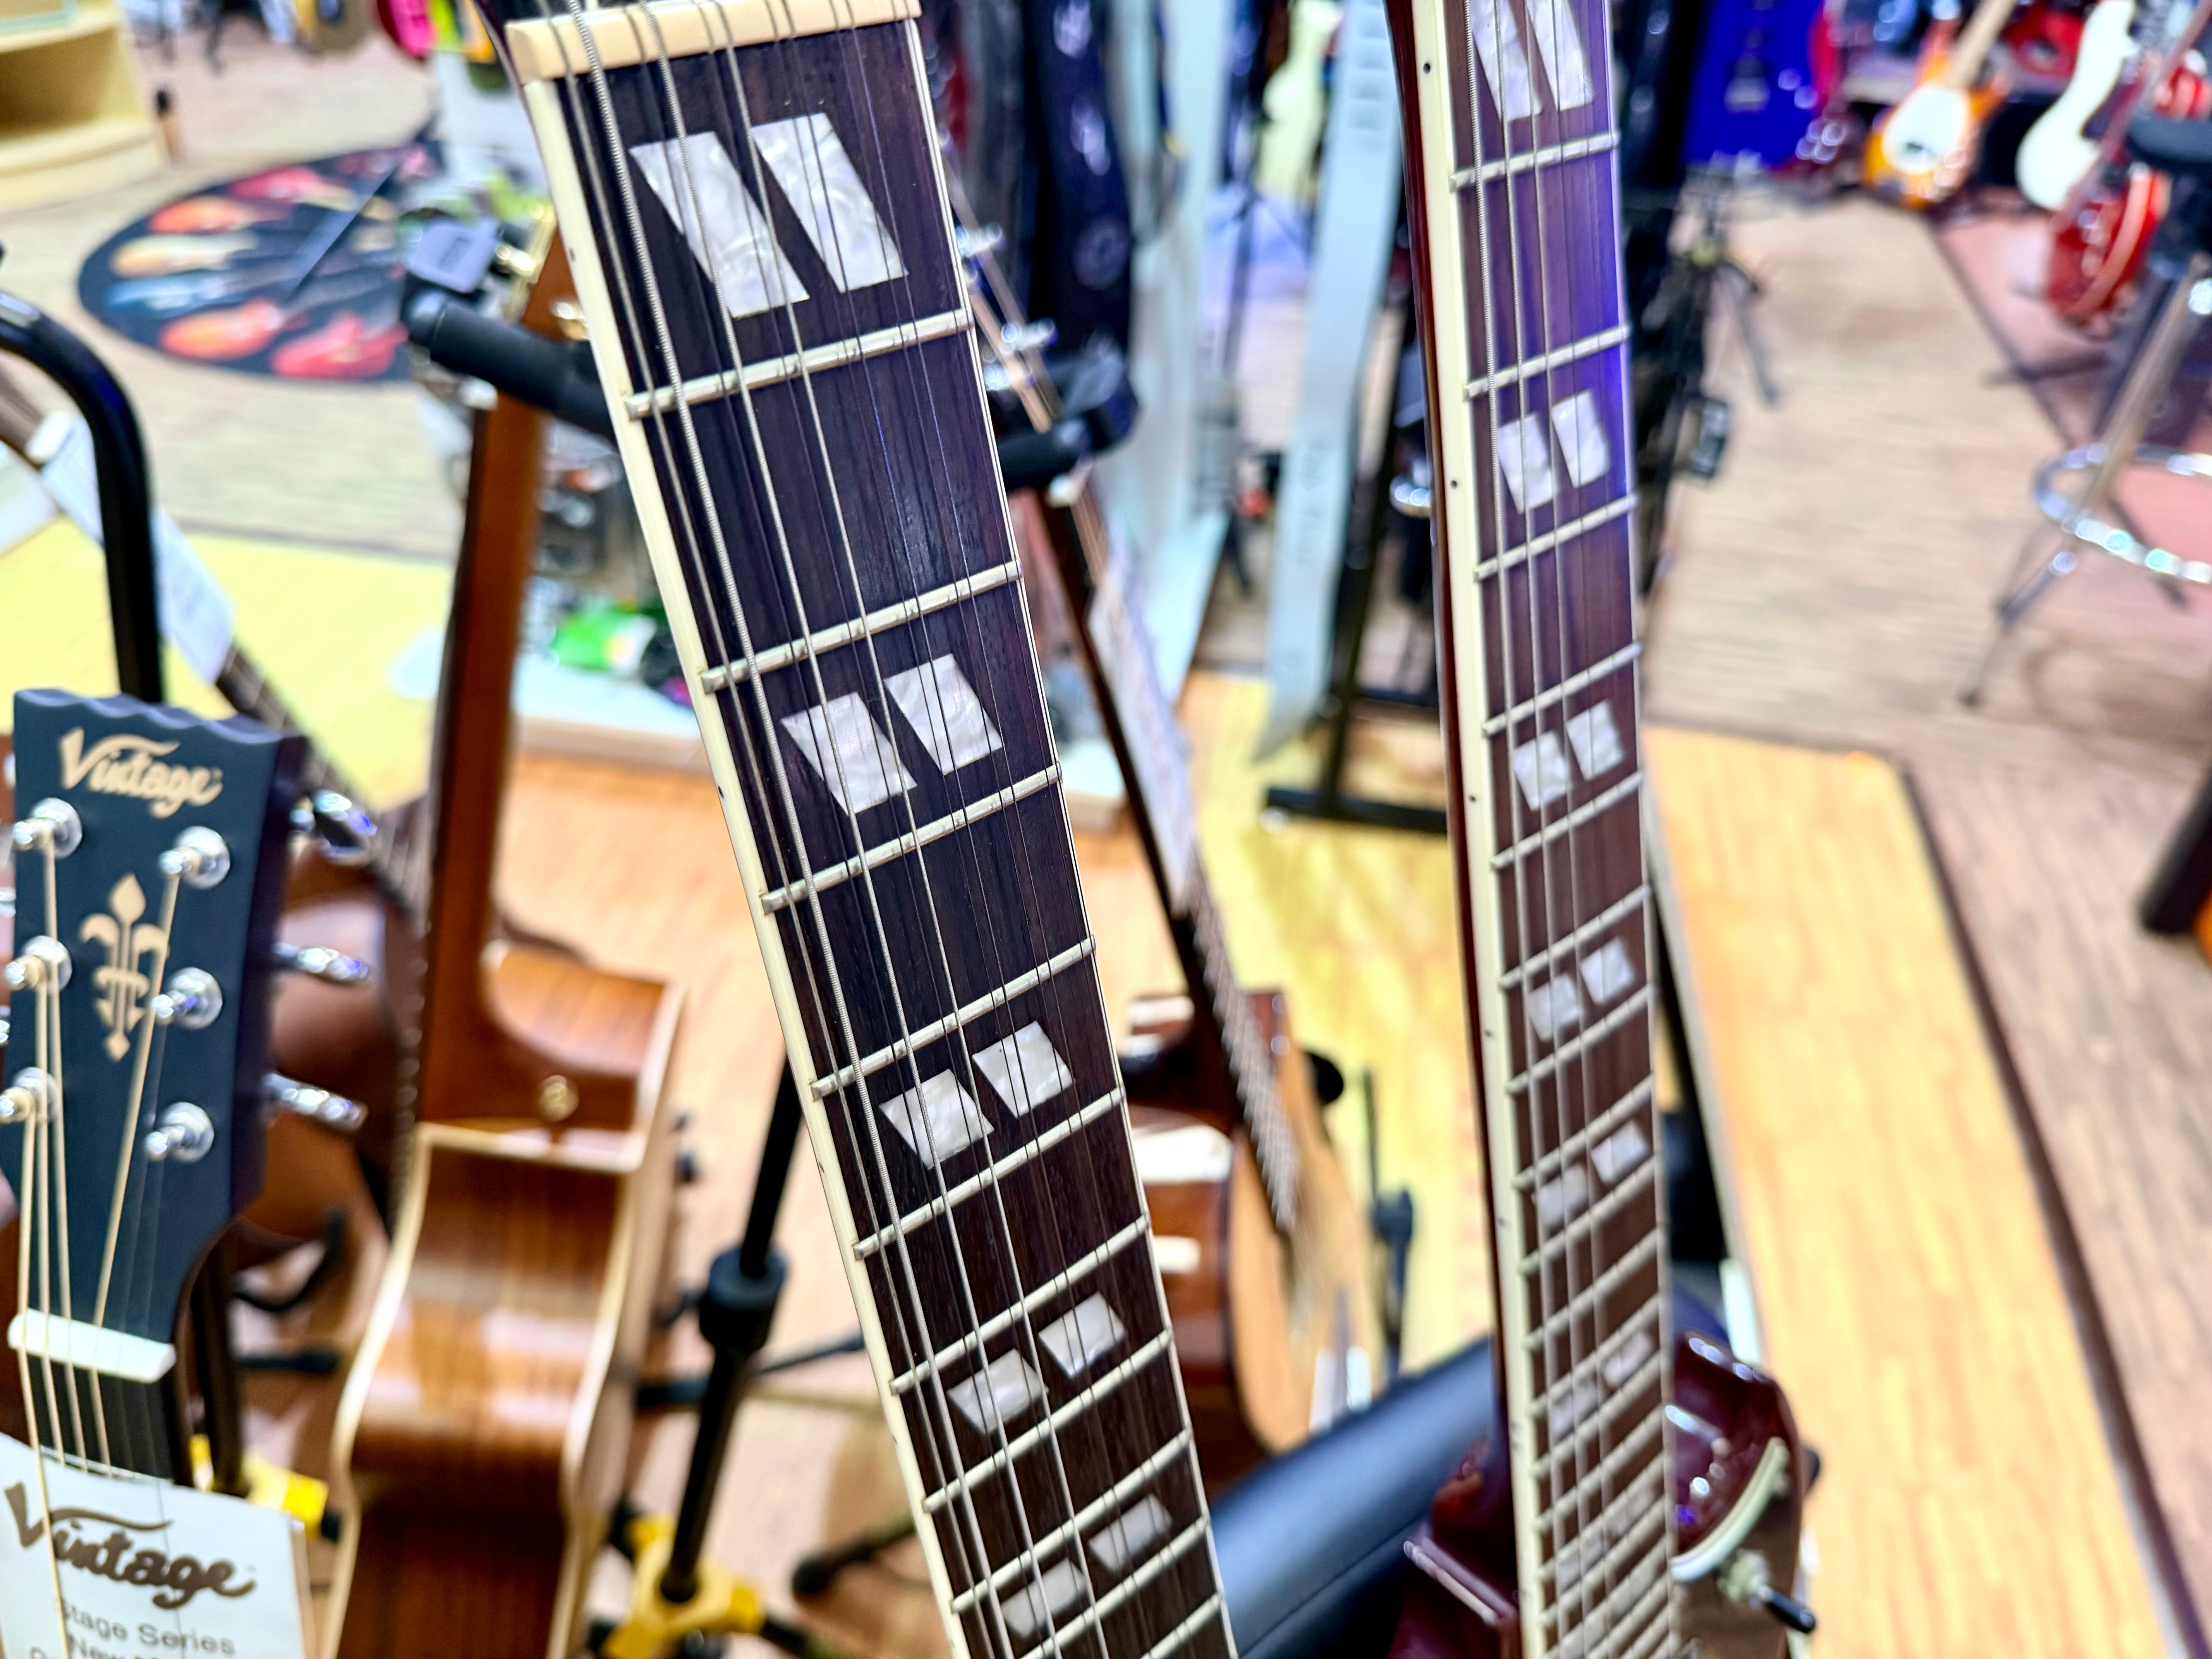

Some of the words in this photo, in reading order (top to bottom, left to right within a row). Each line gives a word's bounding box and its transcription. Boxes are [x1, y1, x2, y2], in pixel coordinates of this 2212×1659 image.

[60, 728, 223, 818] Vintage
[5, 1482, 256, 1609] Vintage
[137, 1623, 236, 1656] Series
